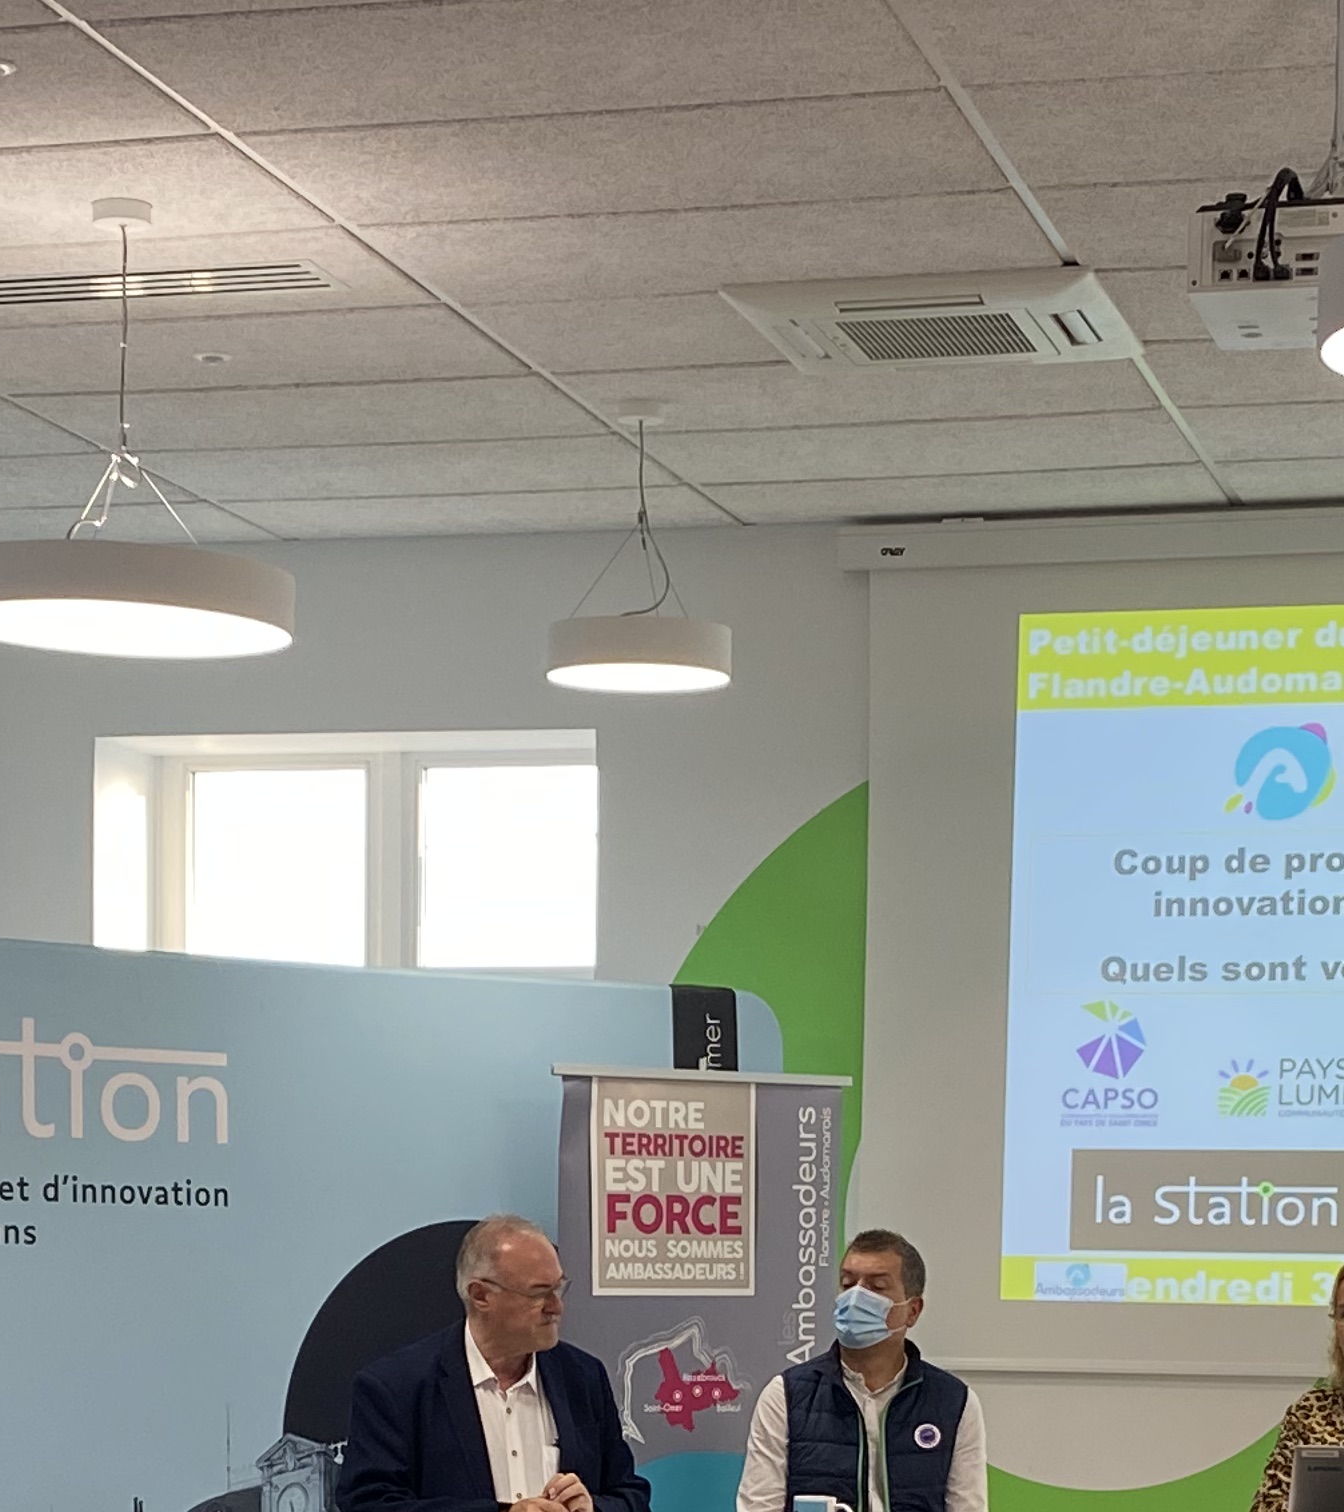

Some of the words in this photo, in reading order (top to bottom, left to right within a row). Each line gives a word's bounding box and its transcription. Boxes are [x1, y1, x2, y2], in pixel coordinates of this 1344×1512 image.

[1028, 624, 1301, 661] Petit-déjeuner
[1113, 848, 1211, 882] Coup
[1223, 846, 1271, 875] de
[1100, 955, 1208, 986] Quels
[1221, 954, 1308, 982] sont
[705, 1012, 722, 1068] mer
[603, 1098, 705, 1130] NOTRE
[1061, 1087, 1159, 1110] CAPSO
[604, 1131, 745, 1159] TERRITOIRE
[819, 1107, 832, 1200] Audomarois
[605, 1158, 666, 1192] EST
[676, 1160, 744, 1194] UNE
[606, 1193, 743, 1236] FORCE
[1094, 1174, 1132, 1225] la
[605, 1238, 658, 1259] NOUS
[666, 1239, 744, 1259] SOMMES
[786, 1106, 818, 1364] Ambassadeurs
[819, 1208, 831, 1267] Flandre
[606, 1261, 737, 1281] AMBASSADEURS
[1034, 1281, 1125, 1297] Ambassadeurs
[1127, 1271, 1294, 1302] endredi
